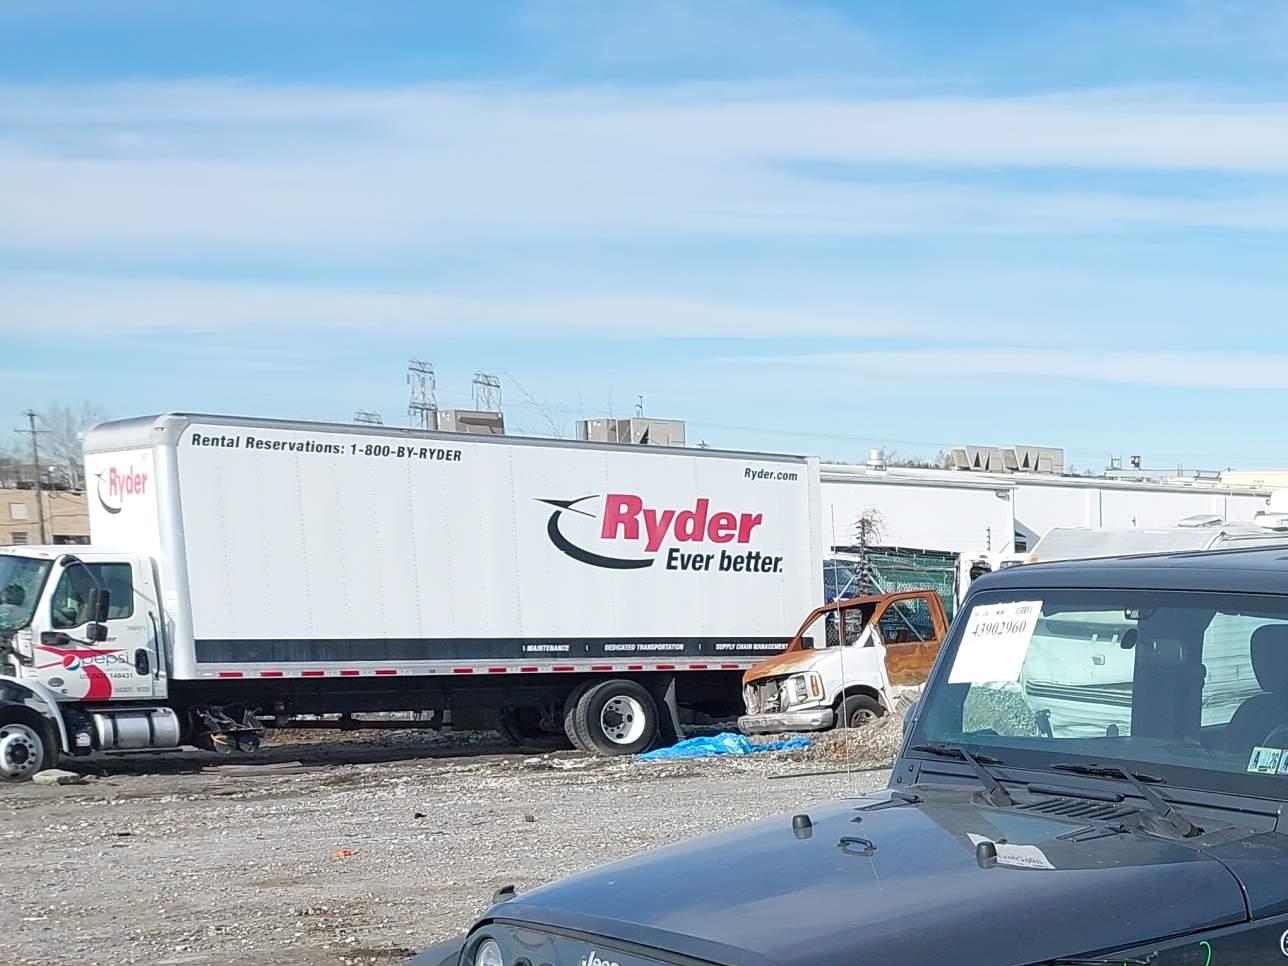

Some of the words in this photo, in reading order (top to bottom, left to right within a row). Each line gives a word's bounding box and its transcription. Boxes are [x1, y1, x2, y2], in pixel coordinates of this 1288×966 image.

[191, 433, 239, 448] Rental
[245, 436, 345, 454] Reservations:
[350, 443, 462, 461] 1-800-BY-RYDER
[109, 465, 147, 503] Ryder
[744, 468, 798, 481] Ryder.com
[600, 493, 763, 552] Ryder
[666, 548, 714, 571] Ever
[719, 550, 783, 573] better.
[972, 620, 1026, 638] 43902960
[526, 644, 570, 652] MAINTENANCE
[604, 643, 636, 651] DEDICATED
[636, 643, 684, 651] TRANSPORTATION
[715, 643, 735, 651] SUPPLY
[736, 643, 752, 651] CHAIN
[753, 643, 789, 651] MANAGEMENT
[82, 652, 129, 667] pepsi
